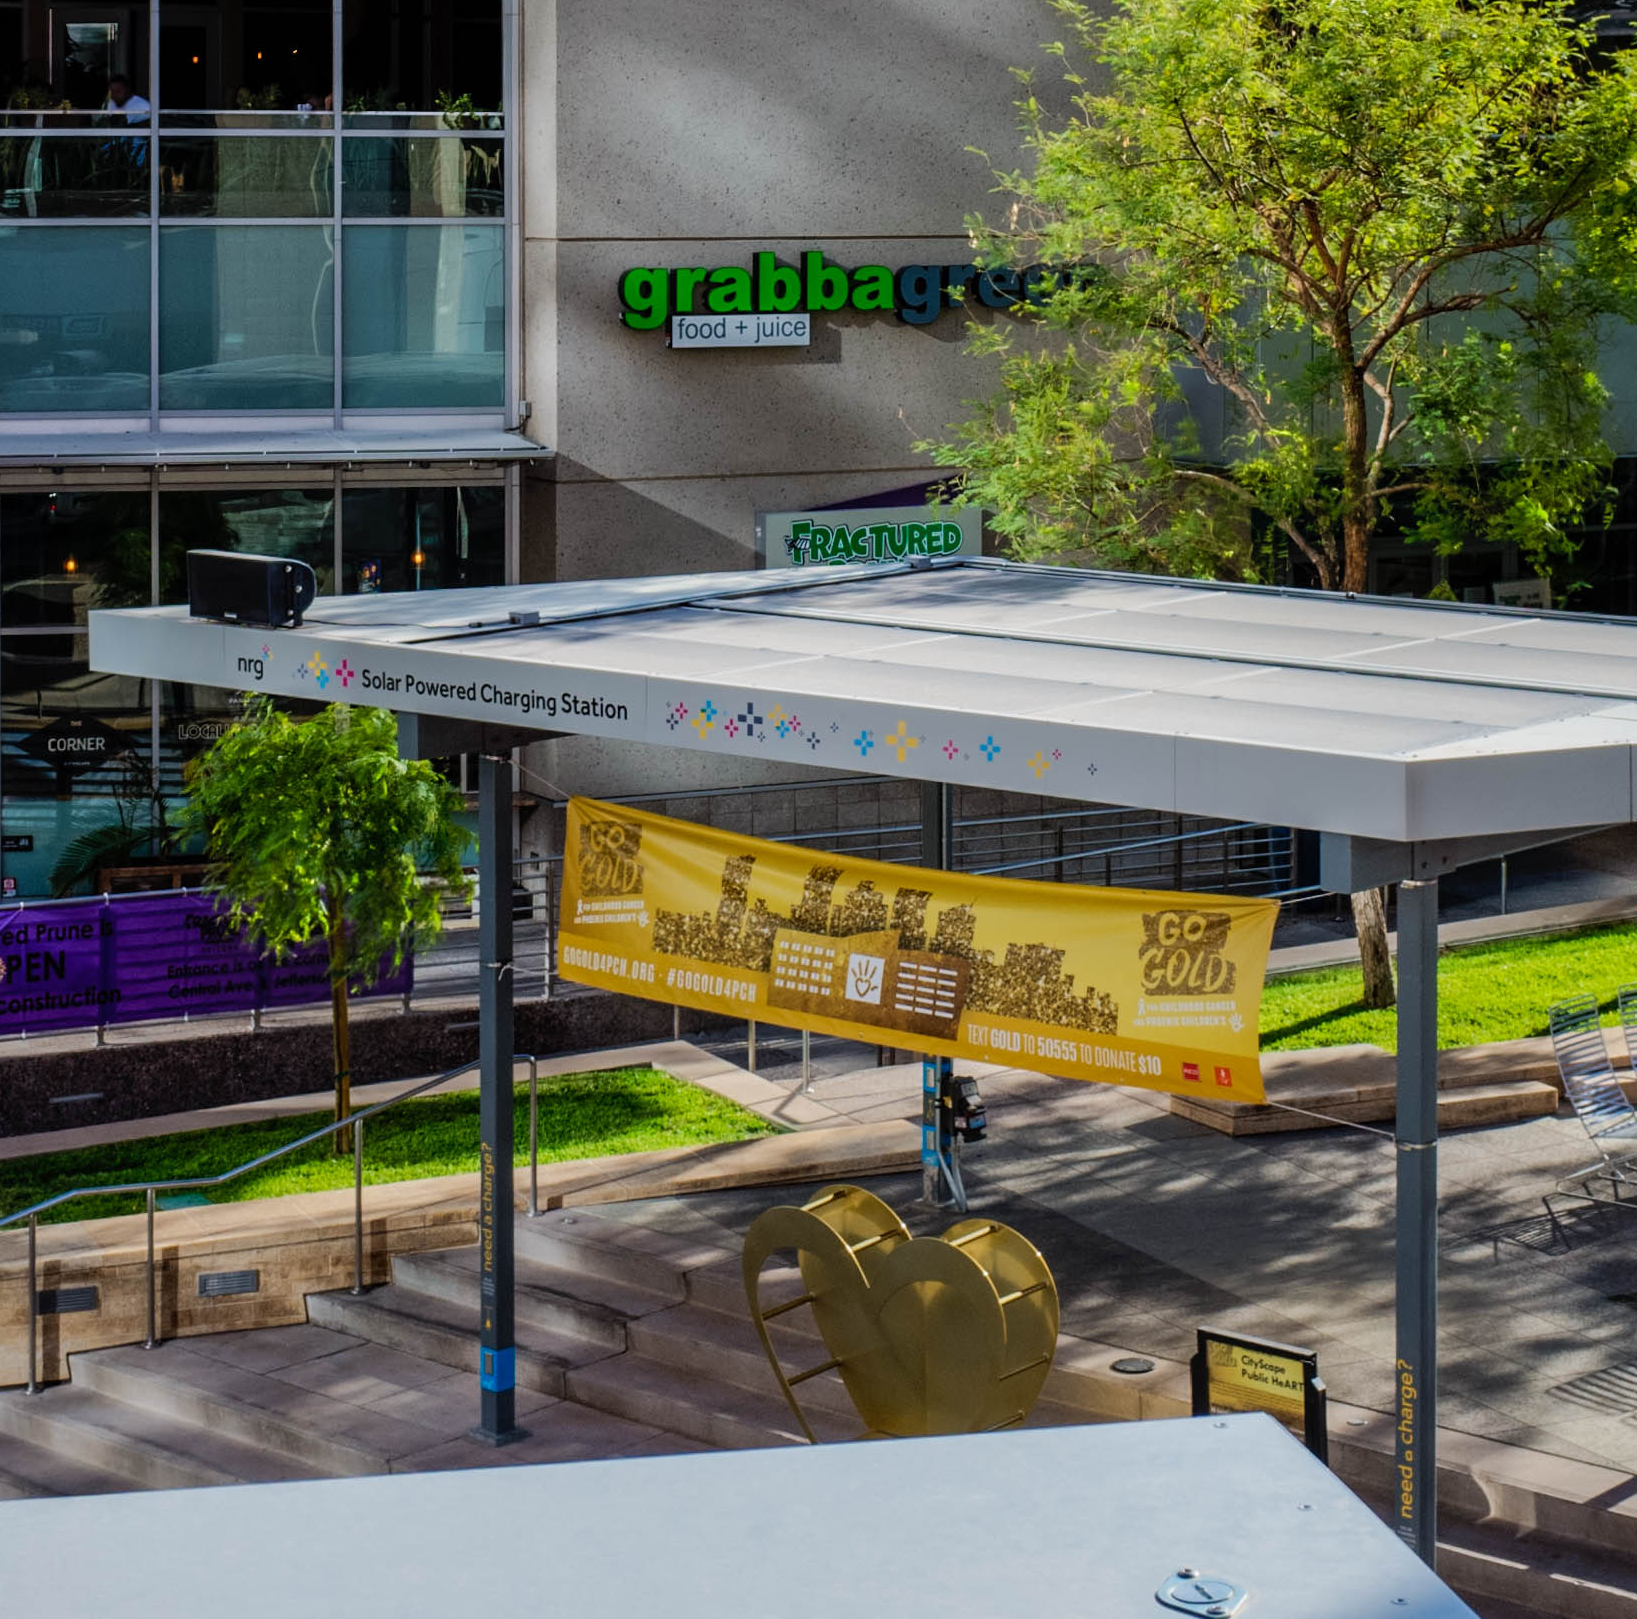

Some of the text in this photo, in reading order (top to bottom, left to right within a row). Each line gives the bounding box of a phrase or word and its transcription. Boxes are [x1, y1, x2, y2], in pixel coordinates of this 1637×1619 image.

[677, 317, 727, 340] food
[753, 316, 808, 344] juice
[789, 519, 963, 566] FRACTURED
[238, 656, 629, 721] nrg Solar Powered Charging Station
[47, 736, 106, 752] CORNER
[590, 825, 625, 853] GO
[581, 852, 639, 892] GOLD
[36, 920, 93, 946] Prune
[99, 918, 115, 938] is
[1158, 911, 1207, 946] GO
[167, 961, 230, 979] Entrance
[563, 945, 757, 1002] GOGOLD4PCH.ORG #GOGOLD4PCH
[1141, 947, 1228, 993] GOLD
[168, 984, 221, 1000] Central
[967, 1023, 989, 1046] TEXT
[990, 1029, 1021, 1053] GOLD
[1023, 1033, 1035, 1054] TO
[1037, 1036, 1077, 1063] 50555
[1080, 1042, 1092, 1065] TO
[1094, 1046, 1137, 1073] DONATE
[1138, 1054, 1162, 1077] $10
[481, 1142, 496, 1213] charge?
[481, 1226, 493, 1273] need
[1241, 1354, 1286, 1375] CityScape
[1241, 1368, 1304, 1392] Public HeART
[1396, 1358, 1417, 1446] charge?
[1398, 1464, 1413, 1519] need
